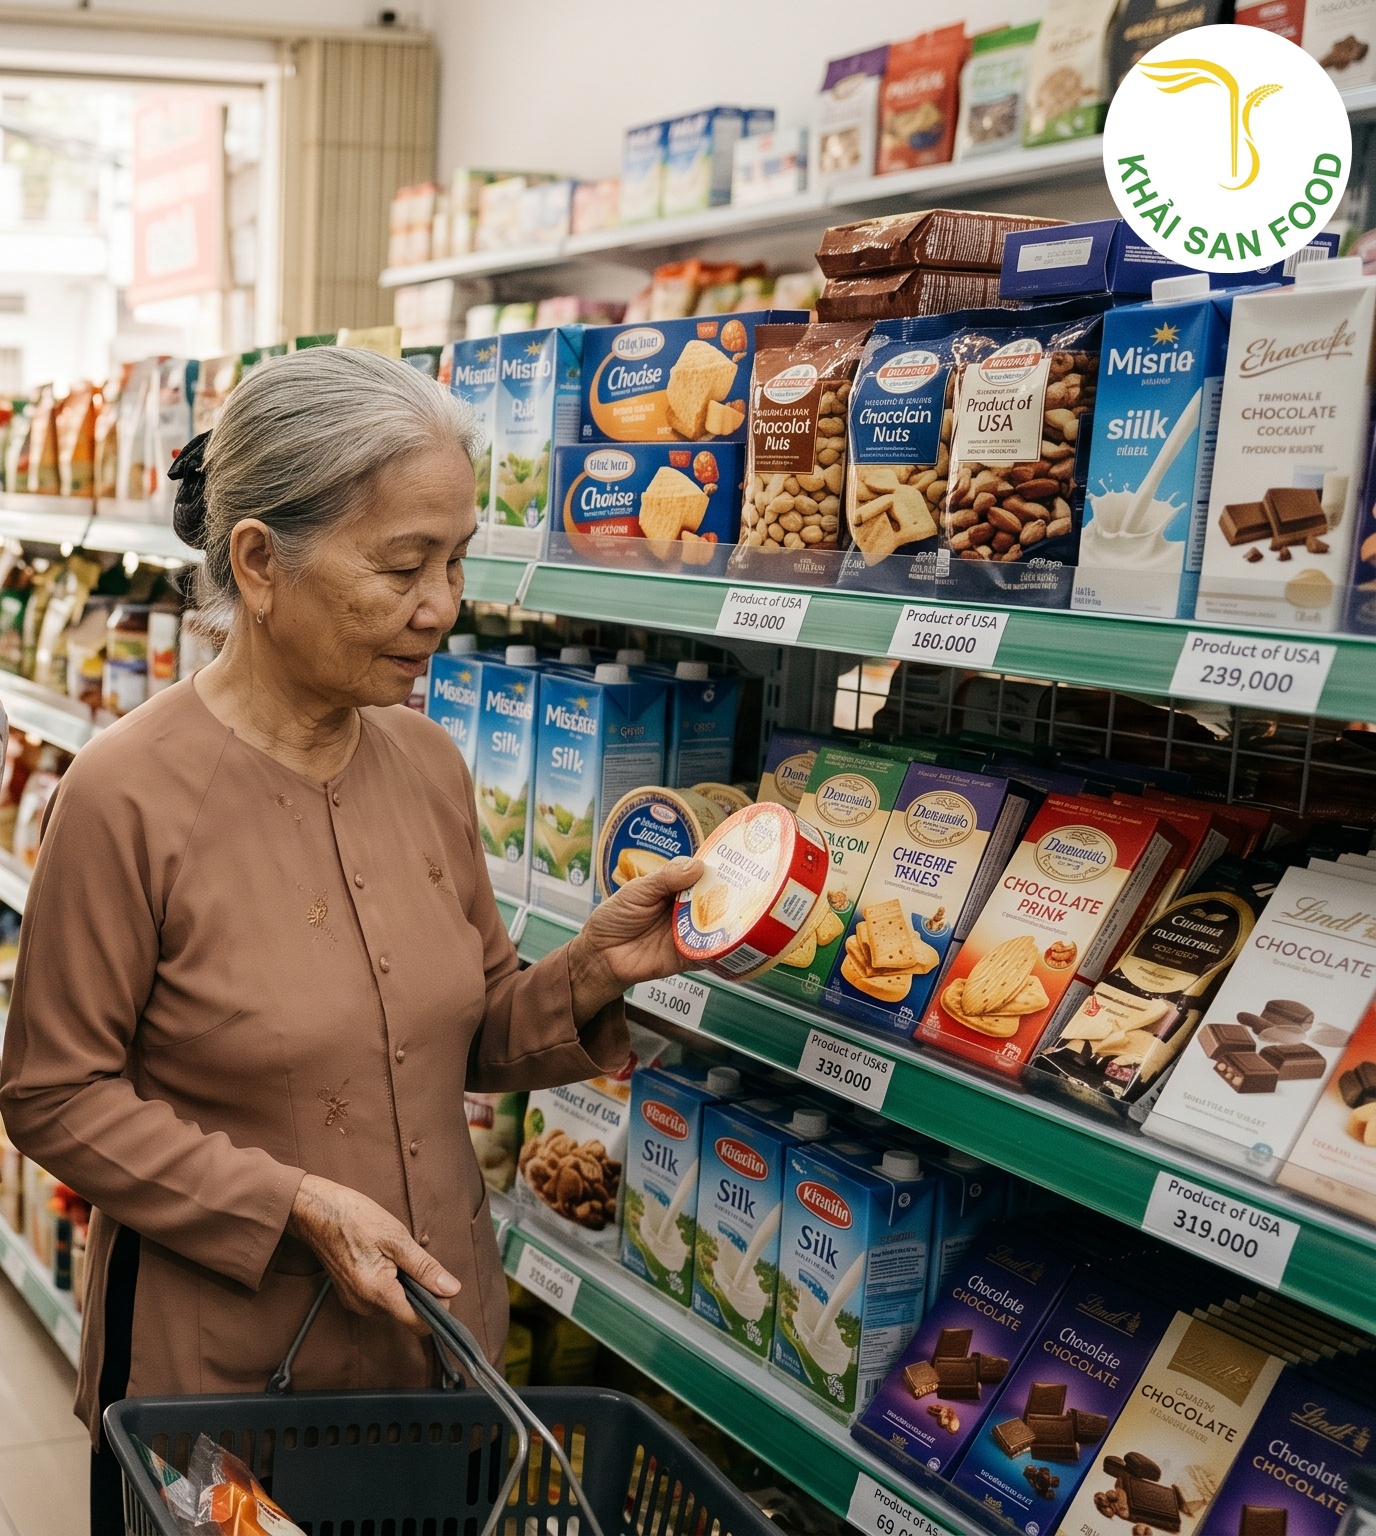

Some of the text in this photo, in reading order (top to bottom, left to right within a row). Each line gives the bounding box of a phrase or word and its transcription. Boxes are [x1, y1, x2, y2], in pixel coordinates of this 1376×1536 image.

[966, 394, 1034, 413] Product of
[1241, 405, 1337, 420] CHOCOLATE
[873, 426, 910, 443] Nuts
[977, 414, 1014, 433] USA
[730, 592, 802, 609] Product of USA
[906, 609, 997, 629] Product of USA
[733, 611, 786, 631] 139,000
[1191, 637, 1321, 665] Product of USA
[1200, 664, 1293, 694] 239,000
[491, 730, 521, 757] Silk
[551, 746, 584, 774] Silk
[1003, 875, 1104, 915] CHOCOLATE
[1017, 898, 1067, 922] PRINK
[1255, 934, 1376, 979] CHOCOLATE
[811, 1034, 849, 1058] Product
[850, 1051, 863, 1063] of
[815, 1057, 872, 1092] 339,000
[586, 1102, 602, 1116] of
[601, 1108, 621, 1127] USA
[642, 1138, 679, 1177] Silk
[716, 1178, 757, 1220] Silk
[1168, 1178, 1281, 1238] Product of USA
[797, 1224, 839, 1271] Silk
[1173, 1208, 1259, 1259] 319.000
[952, 1286, 1022, 1332] CHOCOLATE
[967, 1274, 1025, 1315] Chocolate
[1043, 1339, 1121, 1390] CHOCOLATE
[1059, 1326, 1121, 1370] Chocolate
[1140, 1383, 1239, 1444] CHOCOLATE
[1267, 1438, 1350, 1495] Chocolate
[1251, 1455, 1348, 1517] CHOCOLATE
[874, 1488, 913, 1522] Product
[912, 1517, 926, 1529] of
